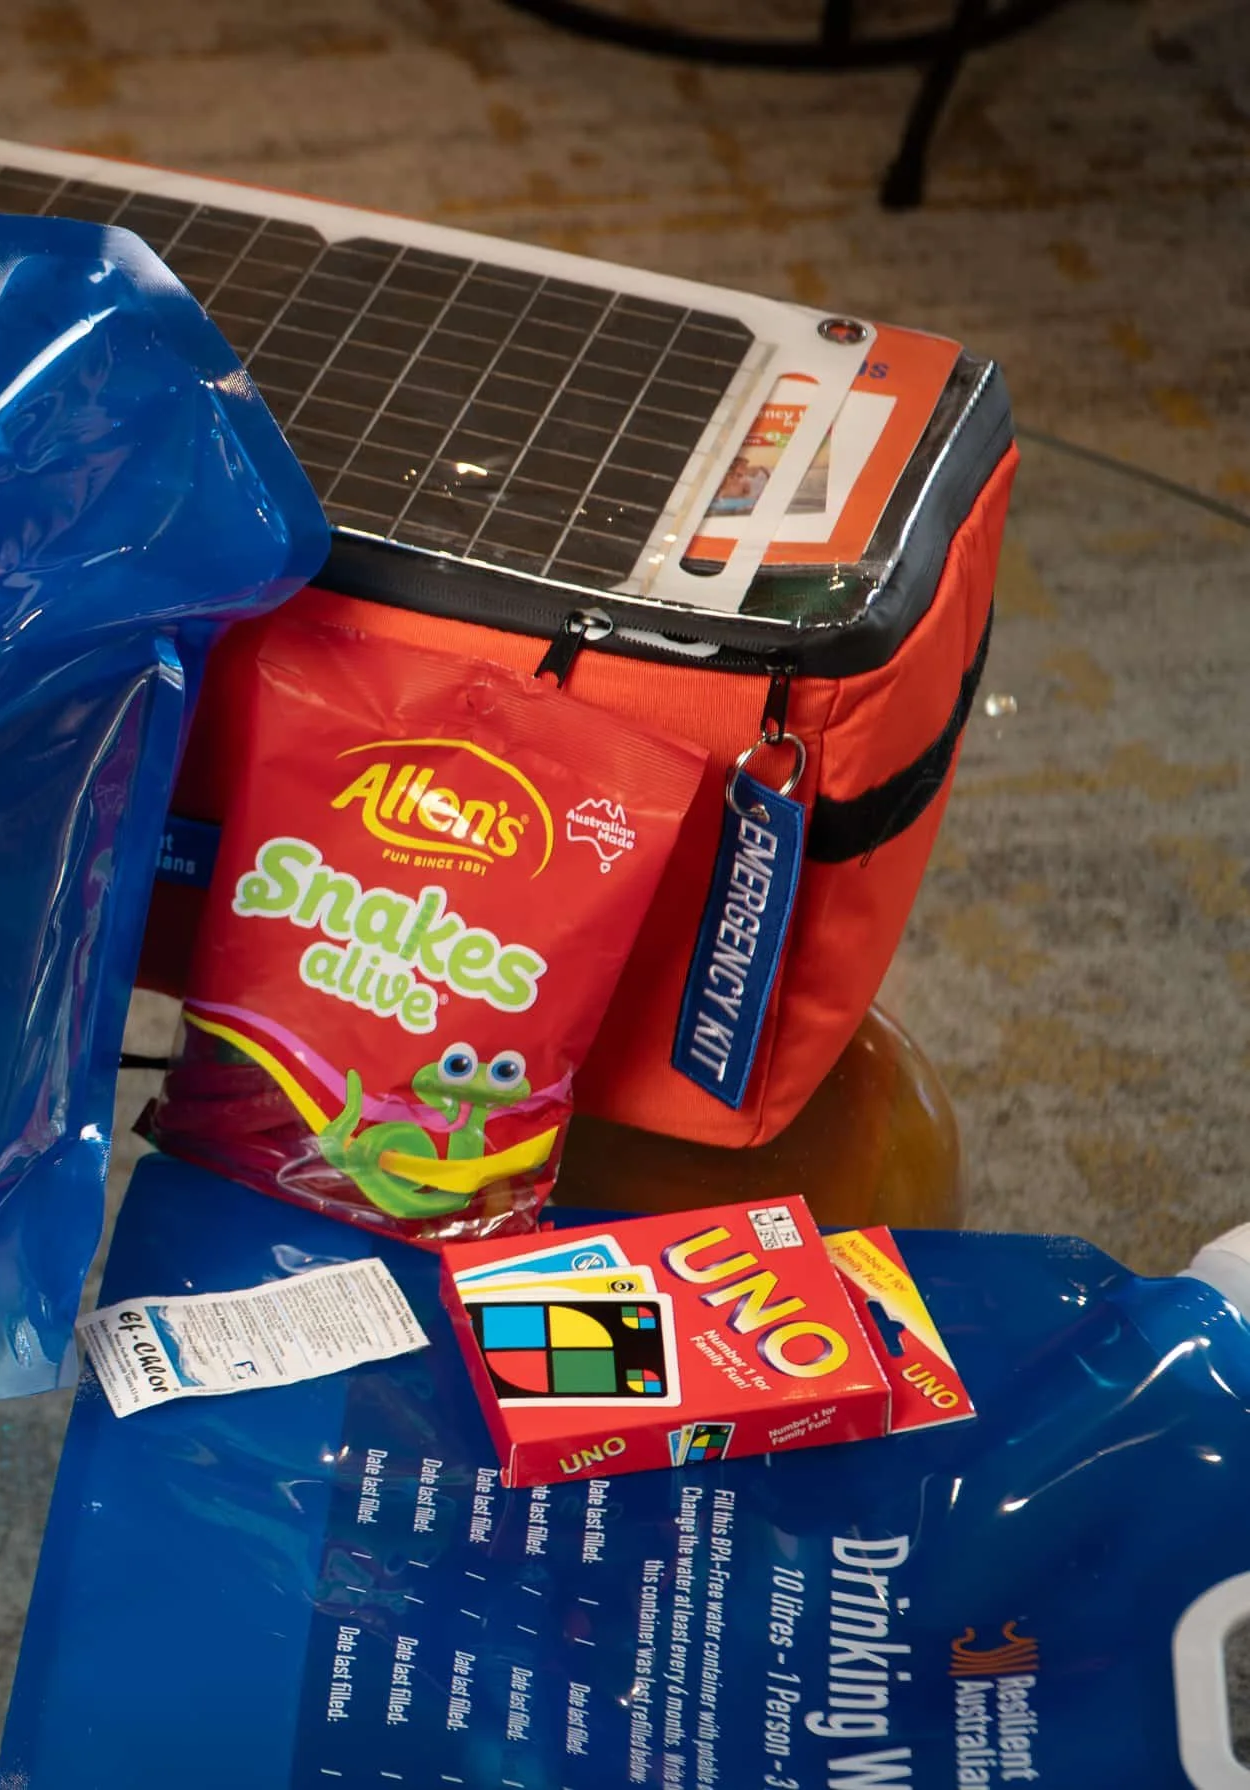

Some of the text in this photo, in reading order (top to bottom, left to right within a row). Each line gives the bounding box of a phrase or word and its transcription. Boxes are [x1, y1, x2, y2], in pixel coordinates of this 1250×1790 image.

[330, 761, 526, 864] Allen's
[566, 808, 636, 840] Australian
[598, 829, 634, 850] Made
[382, 848, 487, 877] FUN SINCE 1891
[234, 839, 547, 1011] Snakes
[690, 818, 777, 1083] EMERGENCY KIT
[300, 943, 437, 1034] alive
[846, 1239, 885, 1272] Number
[660, 1225, 849, 1379] UNO
[690, 1335, 751, 1390] Family Fun!
[703, 1329, 747, 1367] Number
[751, 1375, 773, 1391] for
[902, 1362, 959, 1409] UNO
[769, 1417, 810, 1439] Number
[821, 1406, 837, 1417] for
[771, 1416, 831, 1446] Family Fun!
[559, 1437, 626, 1475] UNO
[357, 1449, 388, 1525] Date last filled:
[413, 1458, 443, 1534] Date last filled:
[469, 1467, 498, 1543] Date last filled:
[713, 1489, 736, 1510] Fill
[529, 1502, 551, 1524] last
[582, 1479, 611, 1564] Date last filled:
[674, 1486, 703, 1533] Change
[711, 1511, 734, 1535] this
[526, 1525, 548, 1556] filled:
[678, 1534, 700, 1555] the
[642, 1559, 665, 1584] this
[675, 1556, 697, 1594] water
[707, 1537, 733, 1599] BPA-Free
[771, 1566, 806, 1593] 10
[638, 1585, 661, 1648] container
[673, 1593, 695, 1610] at
[704, 1600, 726, 1641] water
[769, 1591, 804, 1649] litres
[671, 1610, 695, 1645] least
[804, 1535, 912, 1738] Drinking
[326, 1625, 361, 1722] Date last filled:
[386, 1635, 419, 1726] Date last filled:
[511, 1666, 533, 1691] Date
[635, 1648, 653, 1675] was
[663, 1643, 688, 1685] every
[701, 1641, 724, 1711] container
[767, 1670, 802, 1684] 1
[446, 1650, 476, 1732] Date last filled:
[509, 1690, 531, 1712] last
[568, 1681, 591, 1708] Date
[633, 1676, 657, 1704] last
[667, 1684, 690, 1696] 6
[567, 1706, 590, 1729] last
[631, 1704, 653, 1751] refilled
[663, 1695, 687, 1748] months.
[697, 1710, 721, 1740] with
[764, 1685, 801, 1756] Person
[955, 1680, 997, 1790] Australia
[996, 1675, 1040, 1781] Resilient
[692, 1739, 720, 1785] potable
